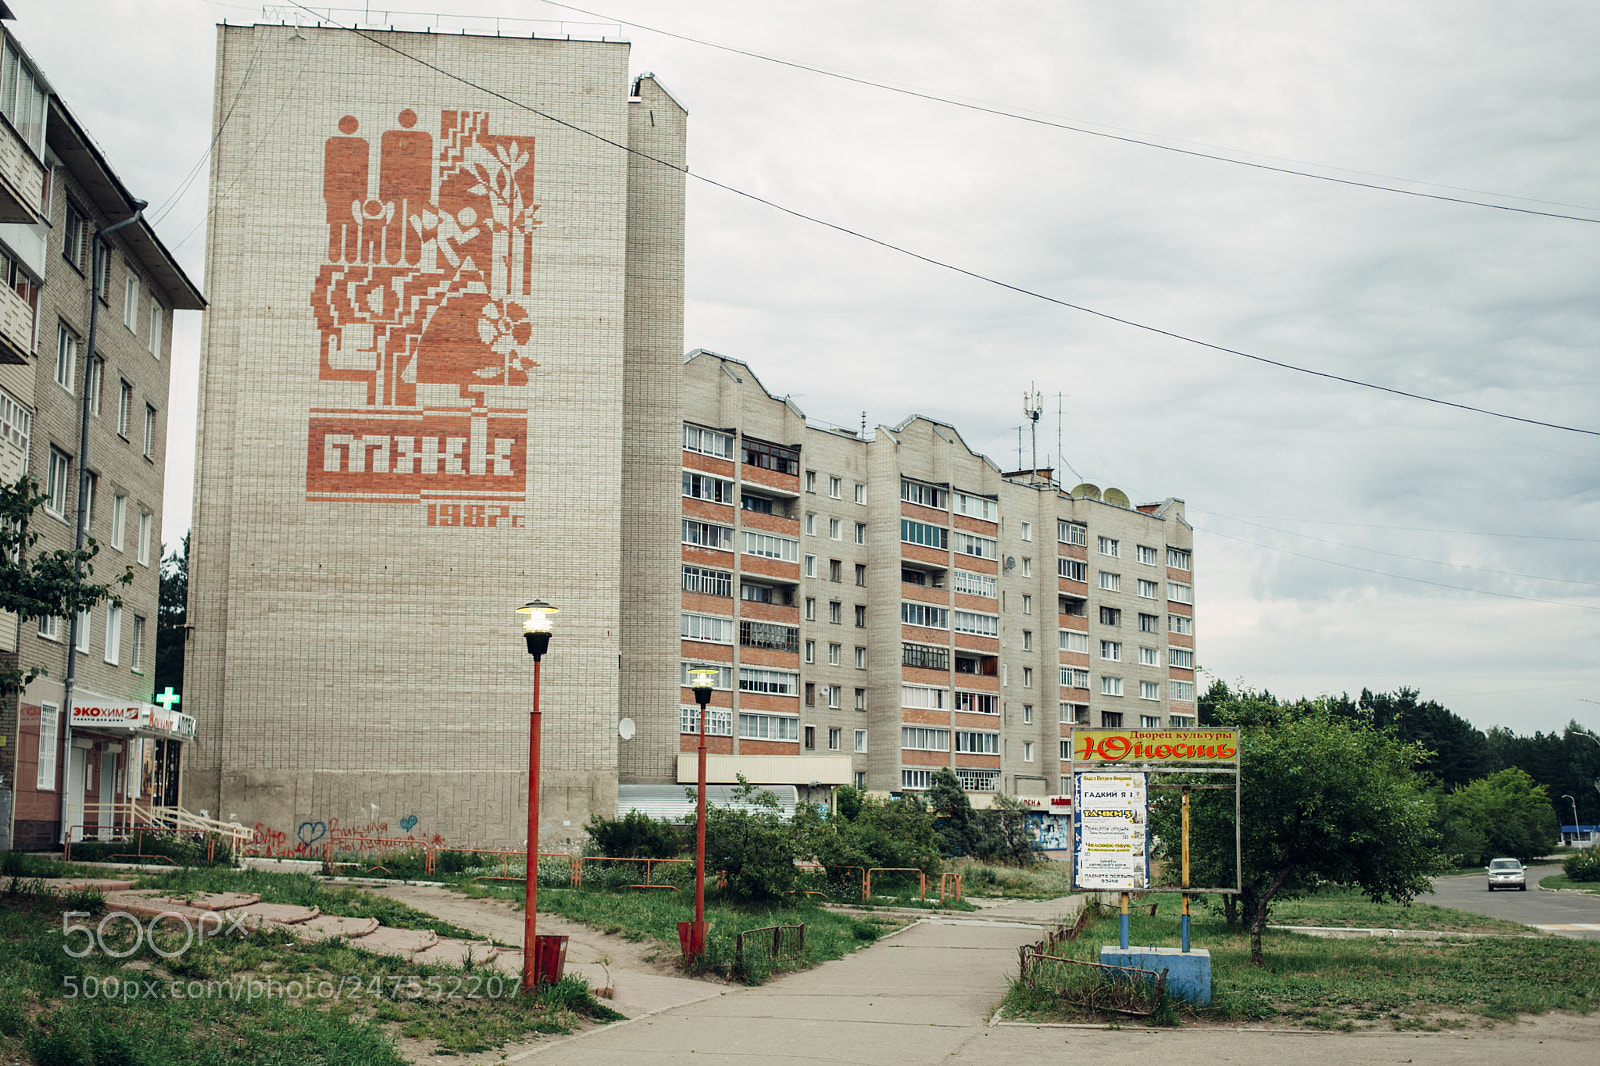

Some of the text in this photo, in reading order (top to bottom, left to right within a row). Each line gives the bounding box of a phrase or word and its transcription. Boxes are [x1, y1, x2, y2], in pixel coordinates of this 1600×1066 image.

[73, 707, 125, 717] ЭКОХИМ
[1130, 731, 1232, 740] Дворец культуры
[1074, 736, 1236, 761] Юность
